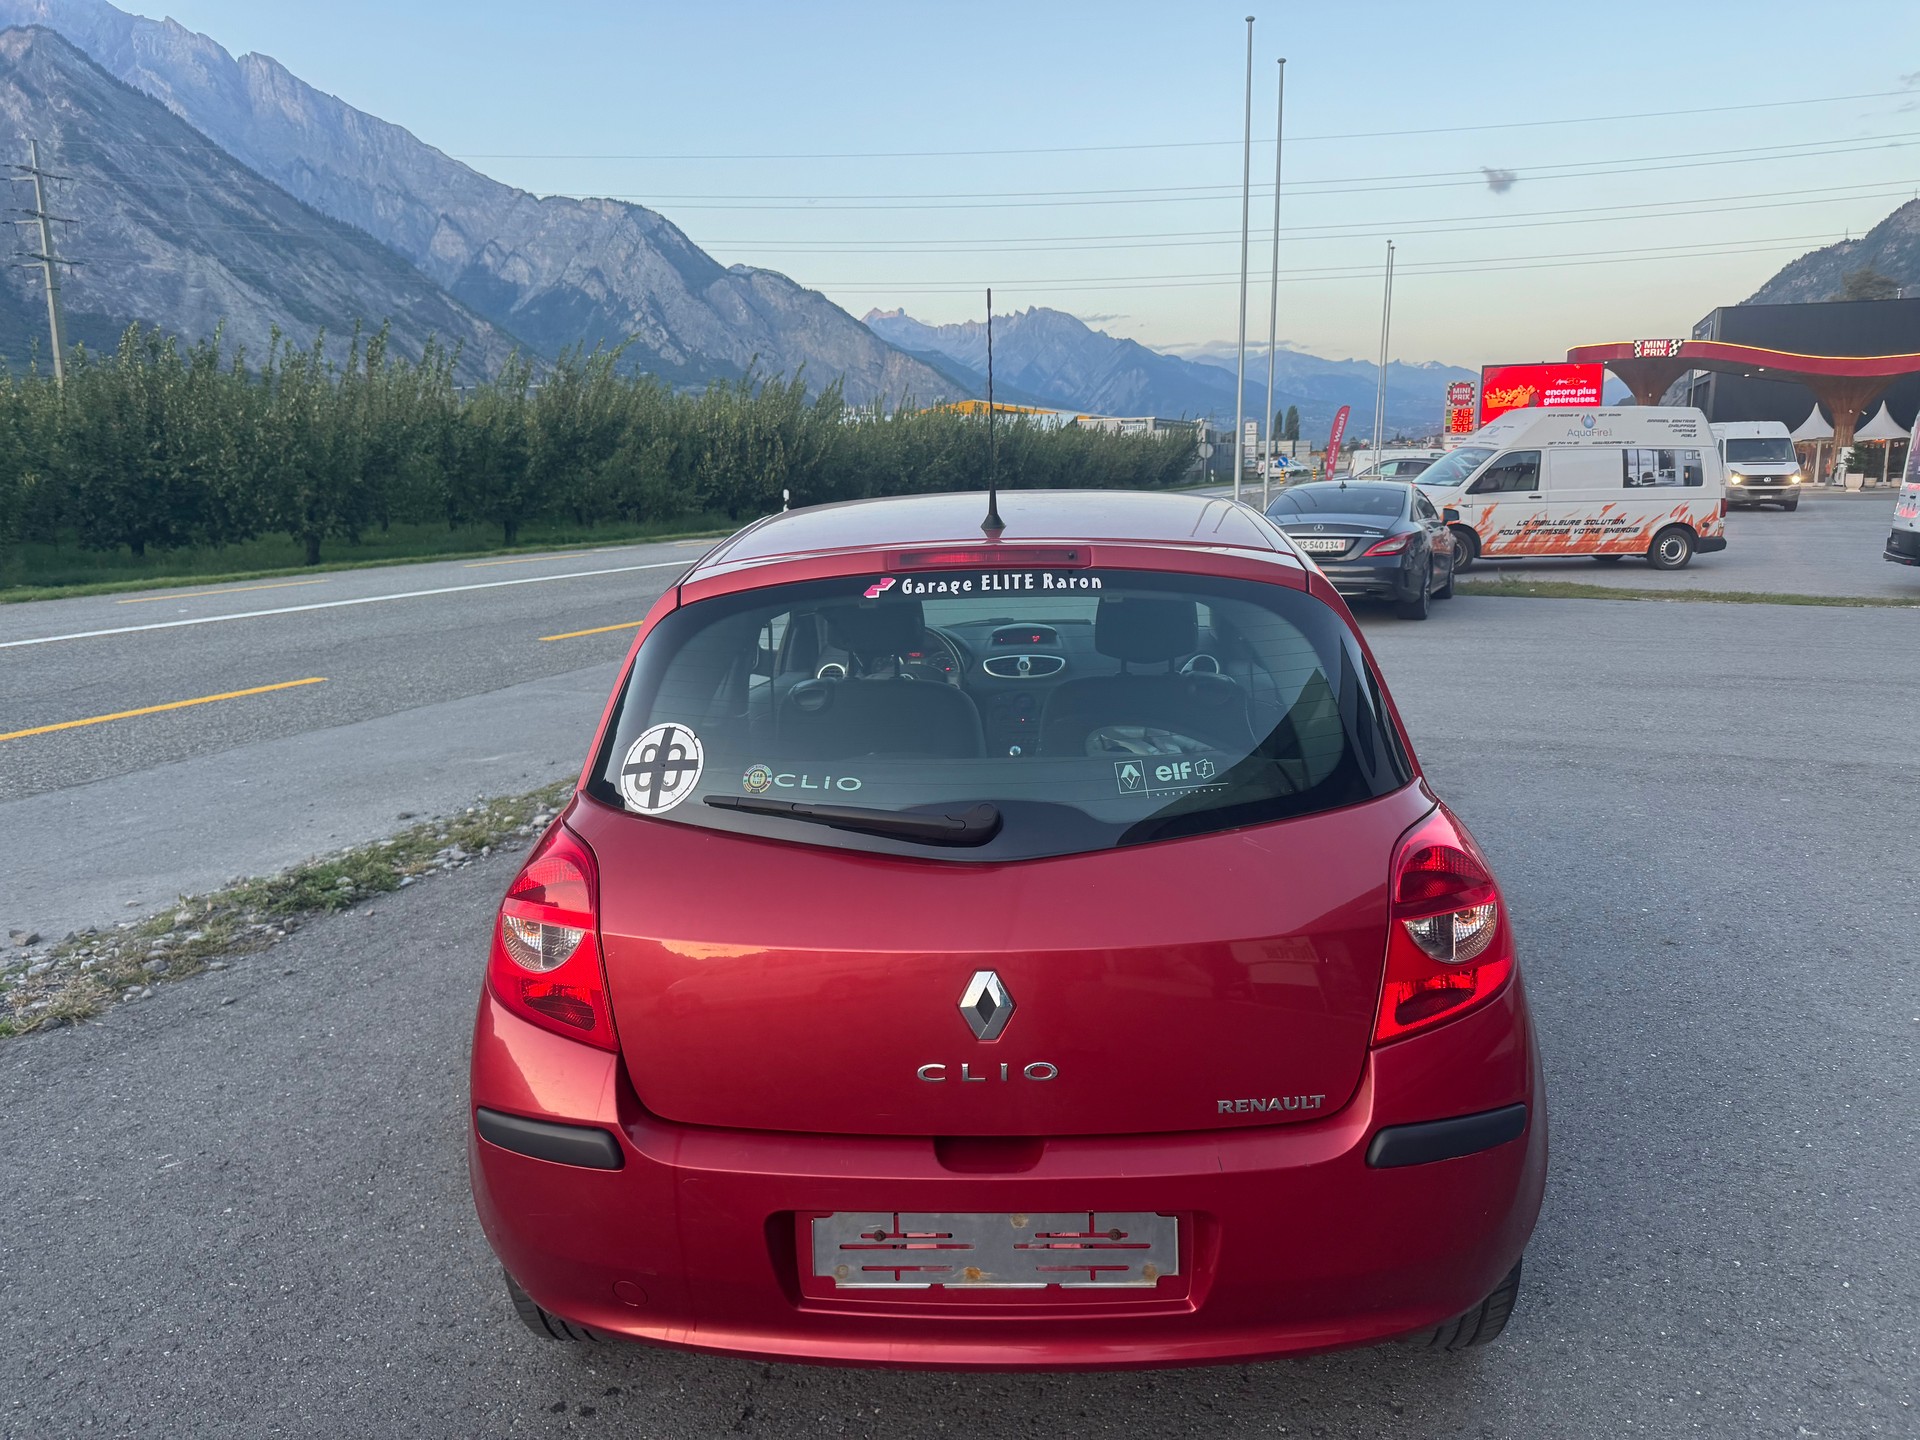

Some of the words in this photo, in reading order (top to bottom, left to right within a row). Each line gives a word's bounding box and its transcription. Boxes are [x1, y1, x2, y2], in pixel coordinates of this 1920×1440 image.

[1644, 340, 1667, 348] MINI
[1643, 348, 1667, 356] PRIX
[1545, 388, 1576, 396] encore
[1577, 386, 1597, 396] plus
[1543, 394, 1598, 406] généreuses.
[1333, 412, 1346, 443] Wash
[1566, 428, 1609, 438] AquaFire
[1584, 518, 1627, 526] SOLUTION
[1604, 526, 1640, 534] ENERGIE
[901, 578, 973, 595] Garage
[981, 574, 1034, 591] ELITE
[1043, 573, 1102, 589] Raron
[1155, 761, 1192, 782] elf
[774, 773, 862, 791] CLIO
[916, 1061, 1059, 1083] CLIO
[1217, 1094, 1326, 1115] RENAULT
